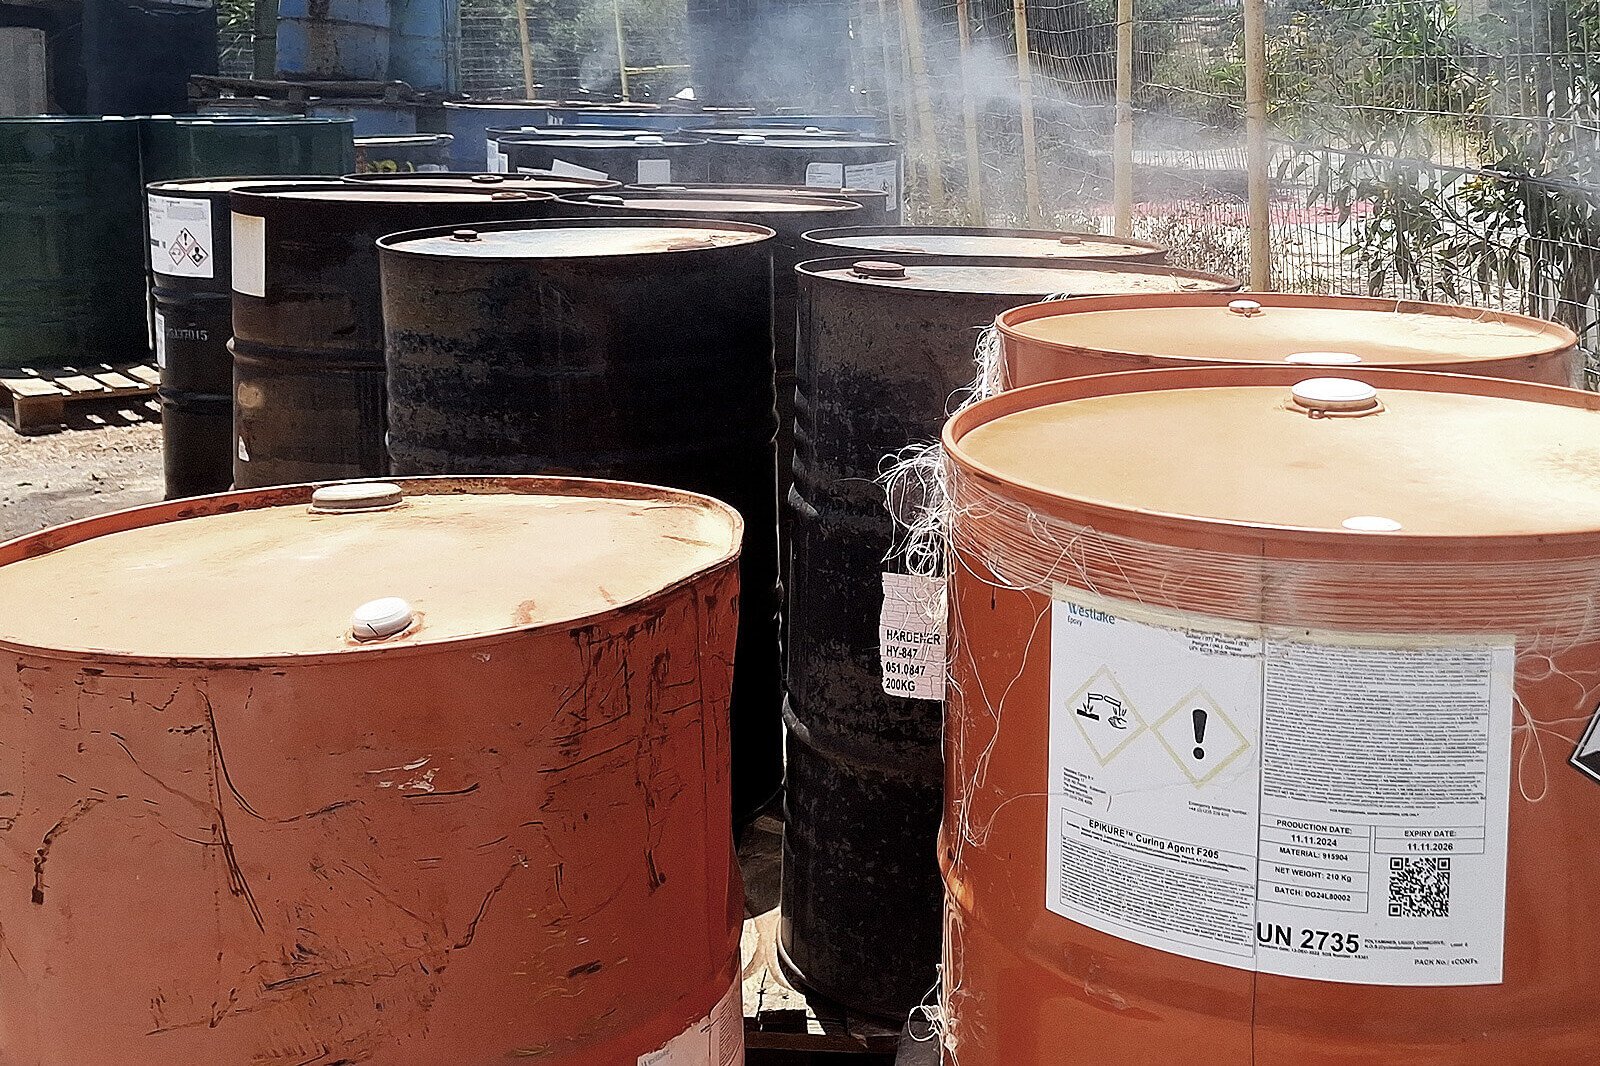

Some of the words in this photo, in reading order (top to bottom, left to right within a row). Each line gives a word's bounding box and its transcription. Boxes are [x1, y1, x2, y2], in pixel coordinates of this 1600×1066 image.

[1067, 601, 1116, 625] Westlake
[886, 629, 941, 645] HARDENER
[886, 645, 918, 659] HY-847
[885, 661, 926, 676] 051.0847
[885, 677, 916, 692] 200KG
[1276, 819, 1328, 833] PRODUCTION
[1329, 825, 1353, 835] DATE:
[1404, 830, 1432, 838] EXPIRY
[1433, 830, 1457, 838] DATE:
[1135, 833, 1165, 850] Curing
[1167, 842, 1195, 855] Agent
[1196, 847, 1220, 860] F205
[1291, 834, 1338, 847] 11.11.2024
[1407, 842, 1454, 852] 11.11.2026
[1279, 846, 1320, 859] MATERIAL:
[1322, 852, 1349, 861] 915904
[1274, 866, 1290, 875] NET
[1291, 868, 1325, 879] WEIGHT:
[1326, 872, 1340, 881] 210
[1341, 874, 1352, 883] Kg
[1274, 885, 1303, 897] BATCH:
[1256, 921, 1292, 947] UN
[1300, 928, 1360, 954] 2735
